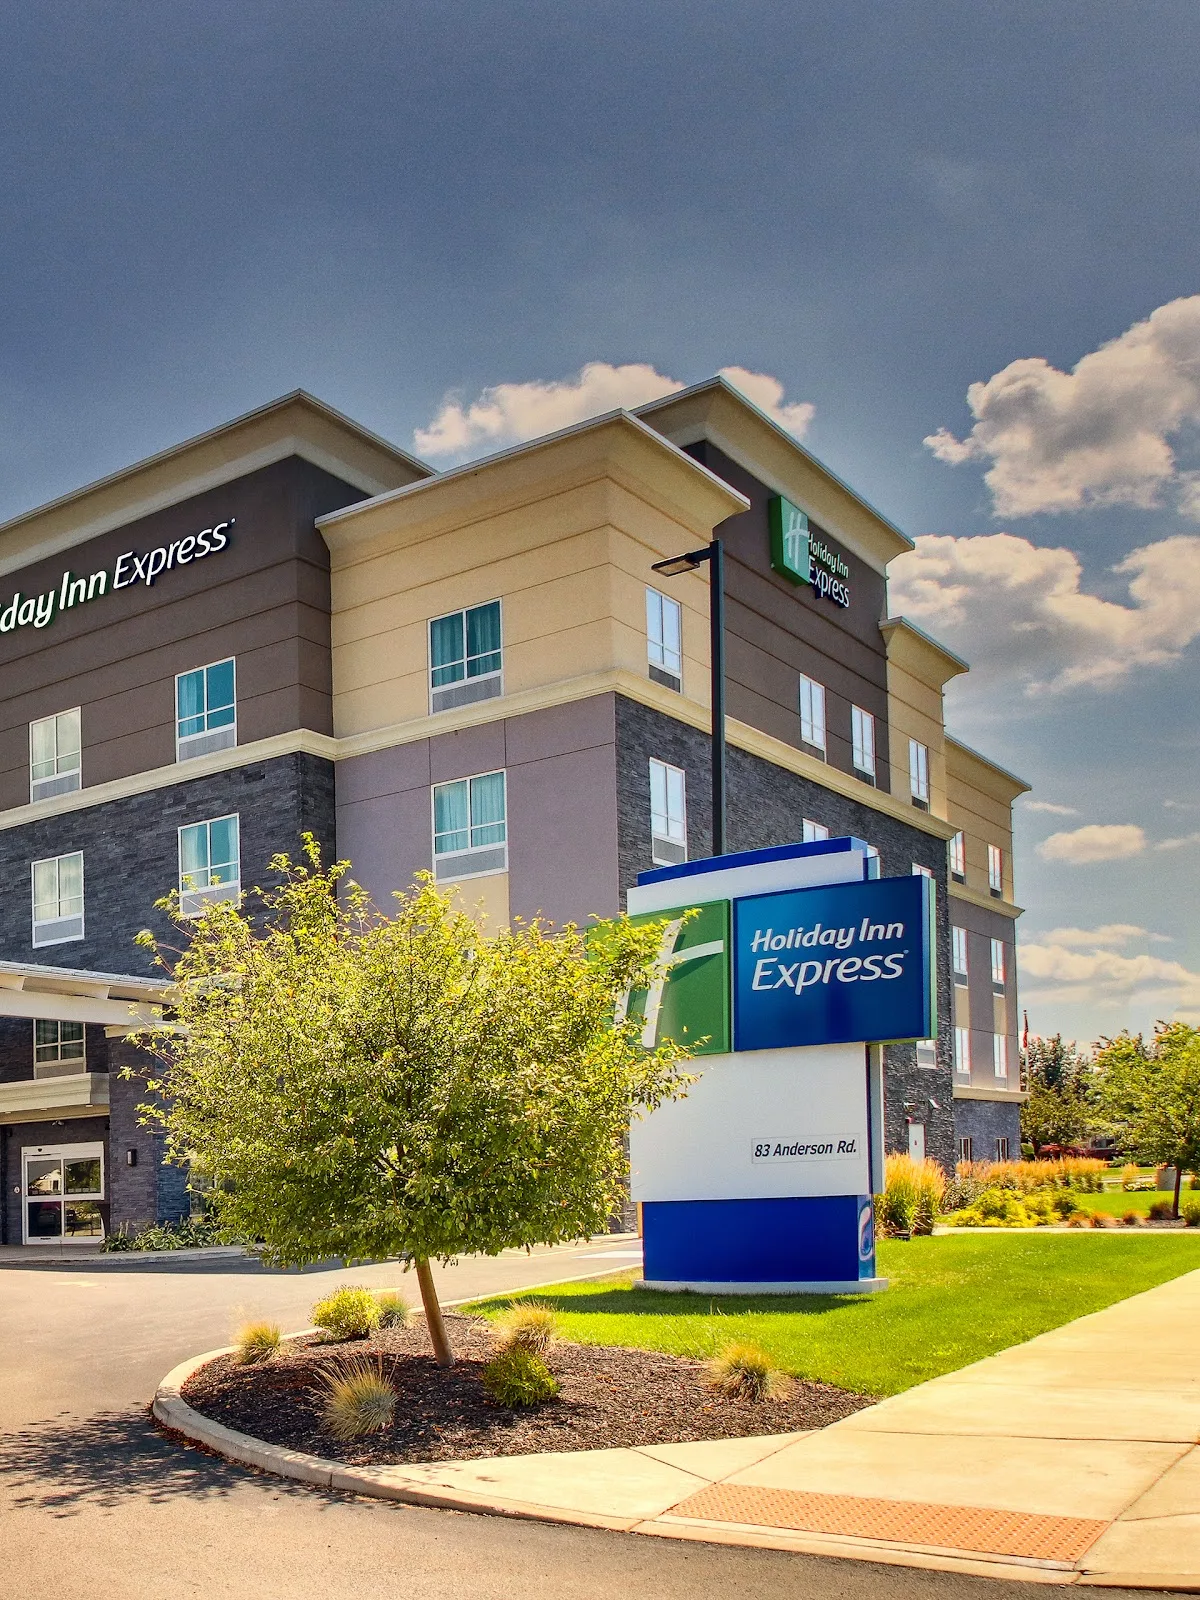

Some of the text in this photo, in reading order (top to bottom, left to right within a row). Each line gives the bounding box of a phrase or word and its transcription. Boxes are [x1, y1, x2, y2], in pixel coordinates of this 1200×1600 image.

[59, 571, 107, 610] Inn
[113, 522, 228, 589] Express
[808, 554, 850, 608] Express
[836, 553, 849, 579] Inn
[750, 917, 904, 953] Holiday Inn
[751, 953, 905, 996] Express
[754, 1139, 857, 1157] 83 Anderson Rd.
